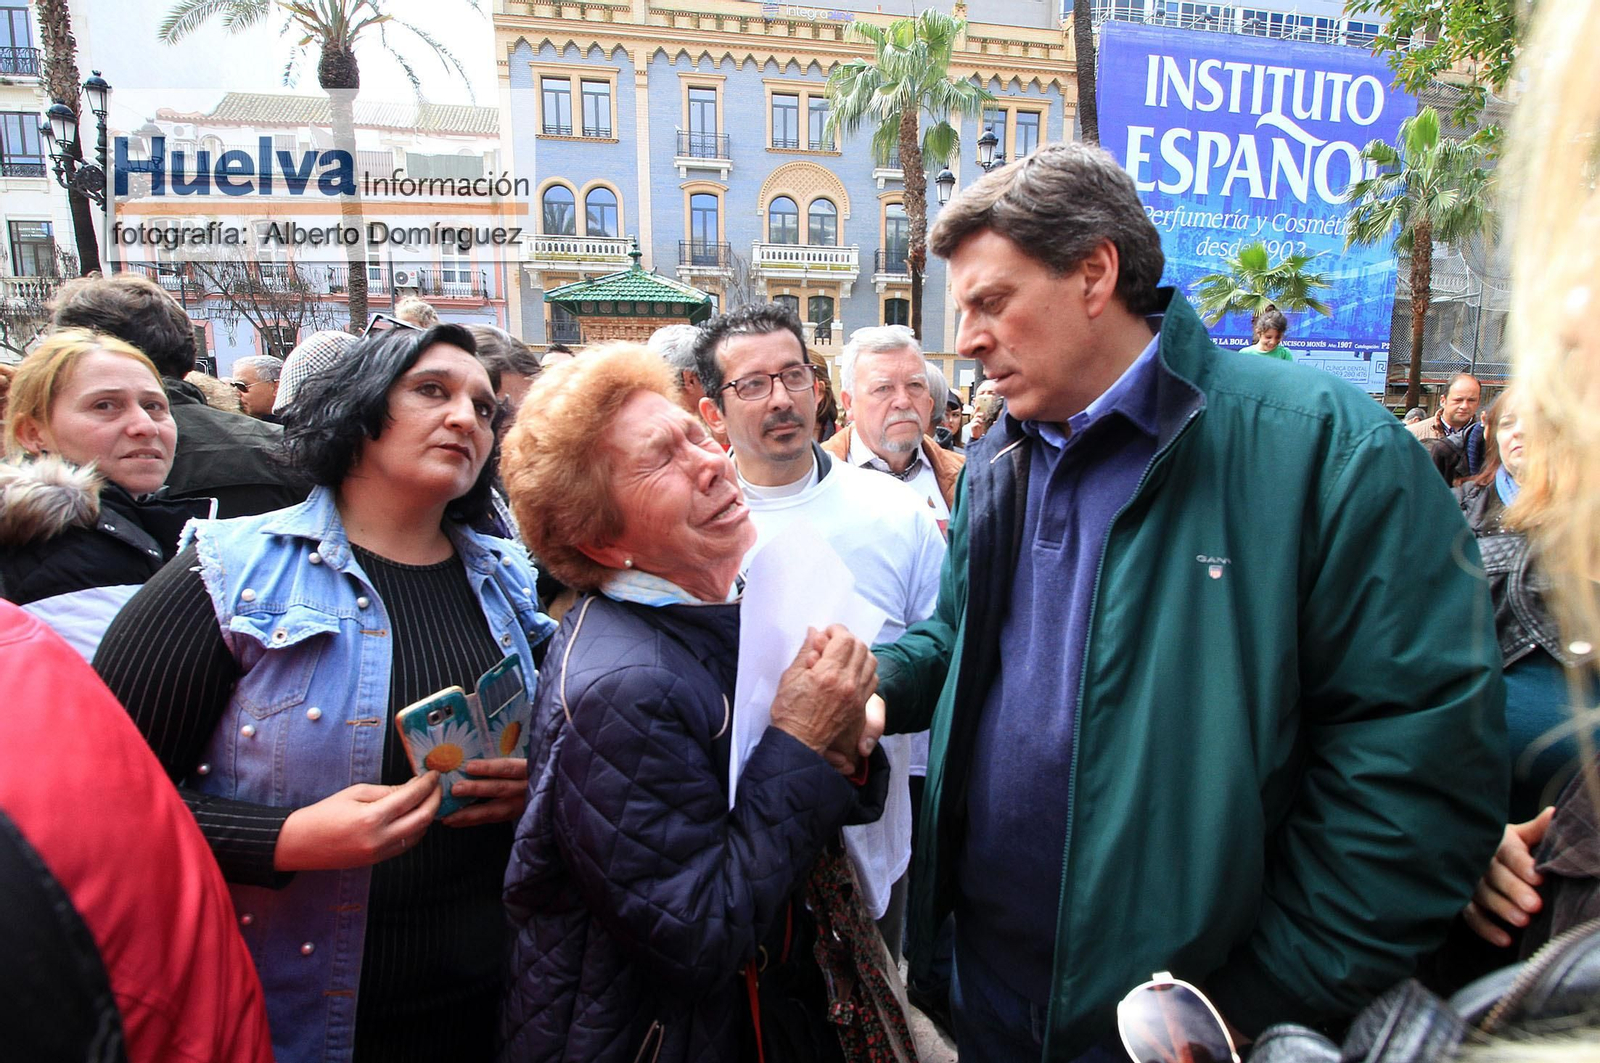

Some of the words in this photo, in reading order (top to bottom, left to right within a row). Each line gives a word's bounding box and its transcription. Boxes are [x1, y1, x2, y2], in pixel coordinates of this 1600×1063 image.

[1144, 54, 1385, 128] INSTITUTO
[1250, 215, 1266, 236] y
[1337, 341, 1353, 349] 1907
